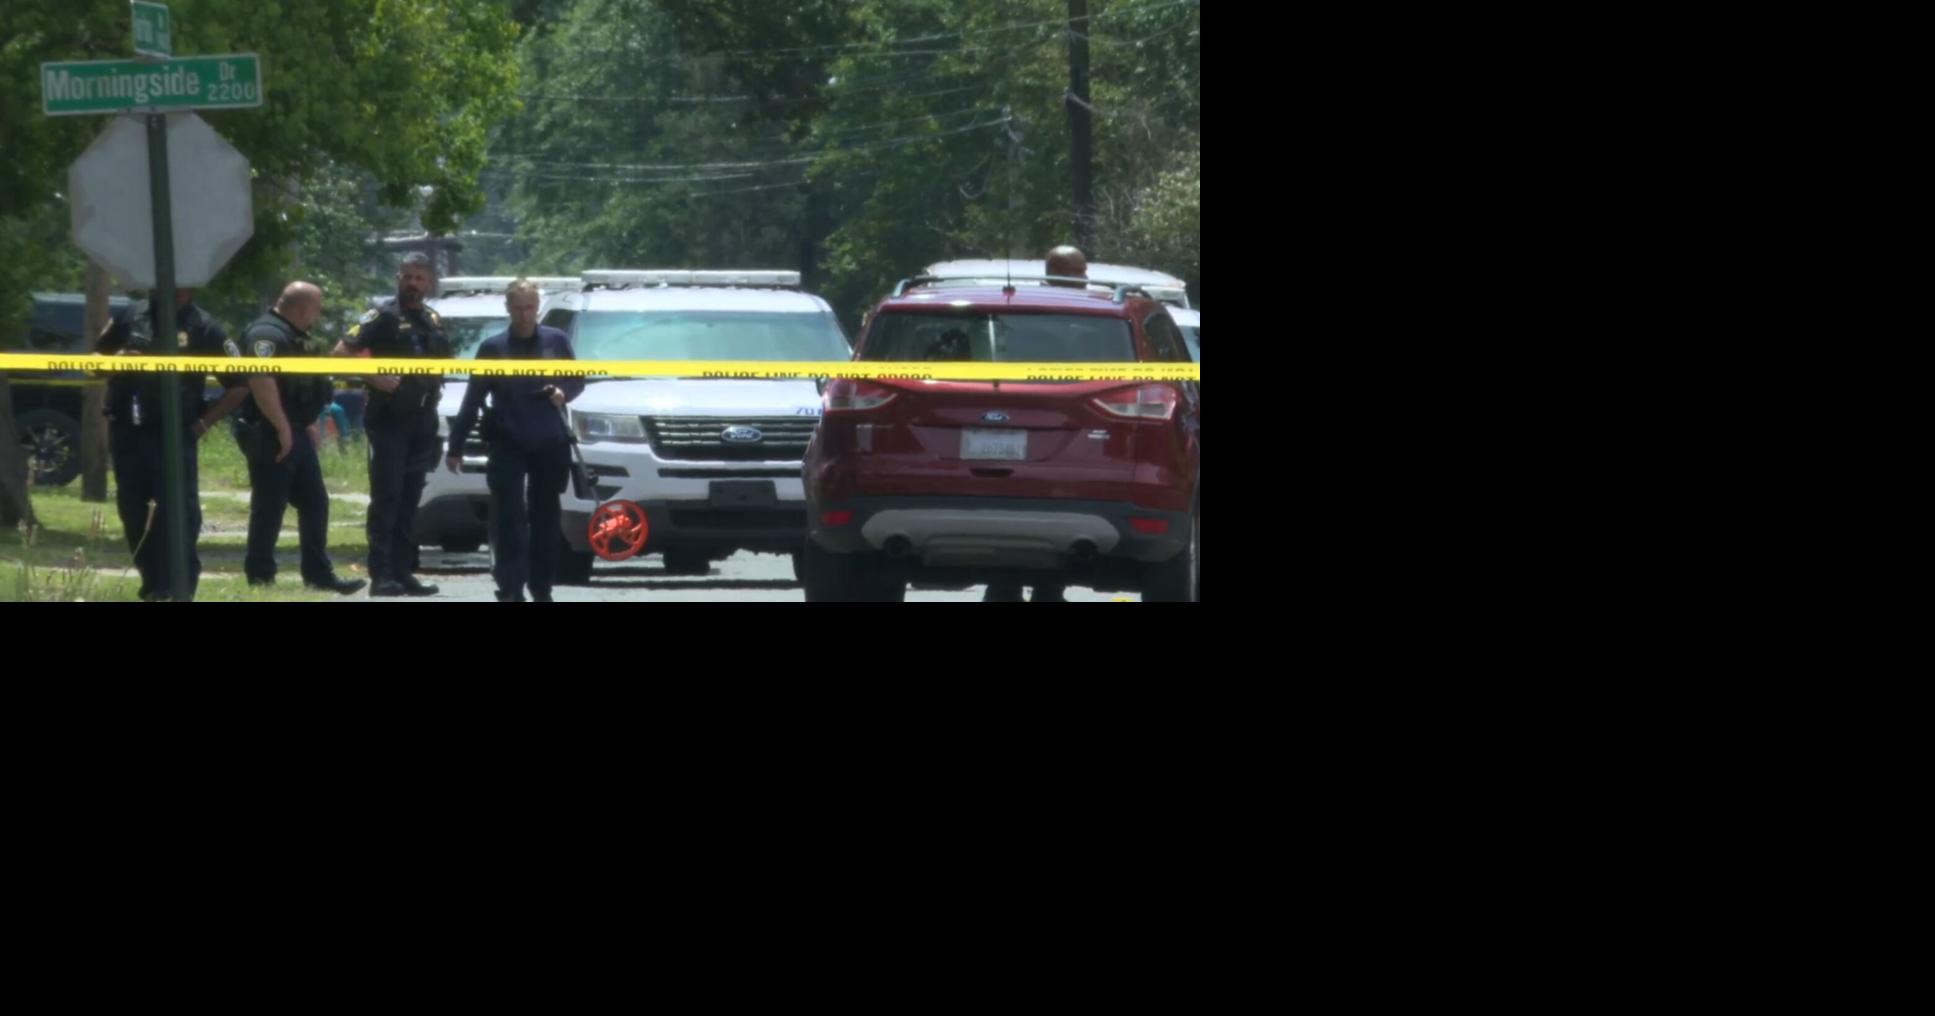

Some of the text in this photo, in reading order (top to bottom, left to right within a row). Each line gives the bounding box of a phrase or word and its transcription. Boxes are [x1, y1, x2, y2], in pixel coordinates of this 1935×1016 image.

[47, 62, 236, 103] Morningside Dr
[207, 83, 256, 101] 2200
